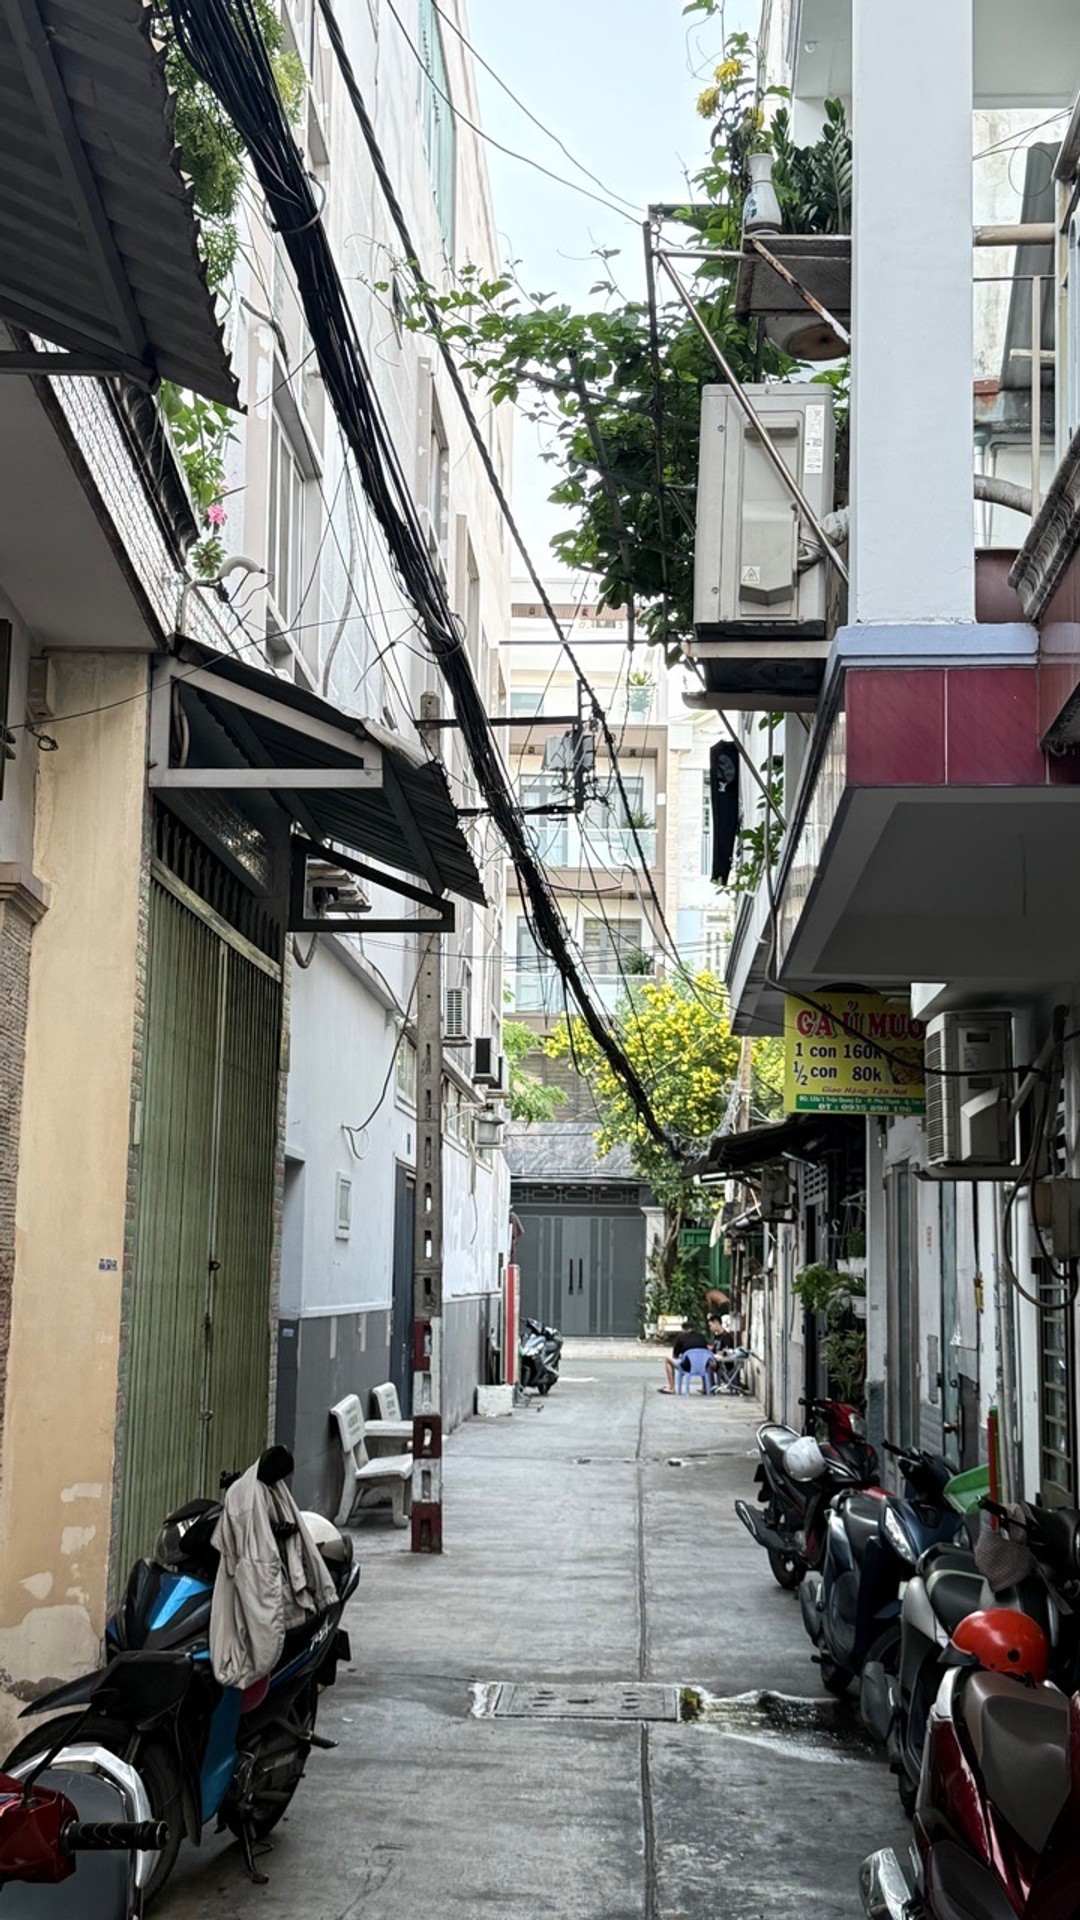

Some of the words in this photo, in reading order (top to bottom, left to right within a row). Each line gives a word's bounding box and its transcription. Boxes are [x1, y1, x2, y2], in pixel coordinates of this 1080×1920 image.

[795, 1042, 803, 1057] 1
[810, 1046, 837, 1058] con
[810, 1066, 837, 1078] con
[852, 1066, 882, 1082] 80k
